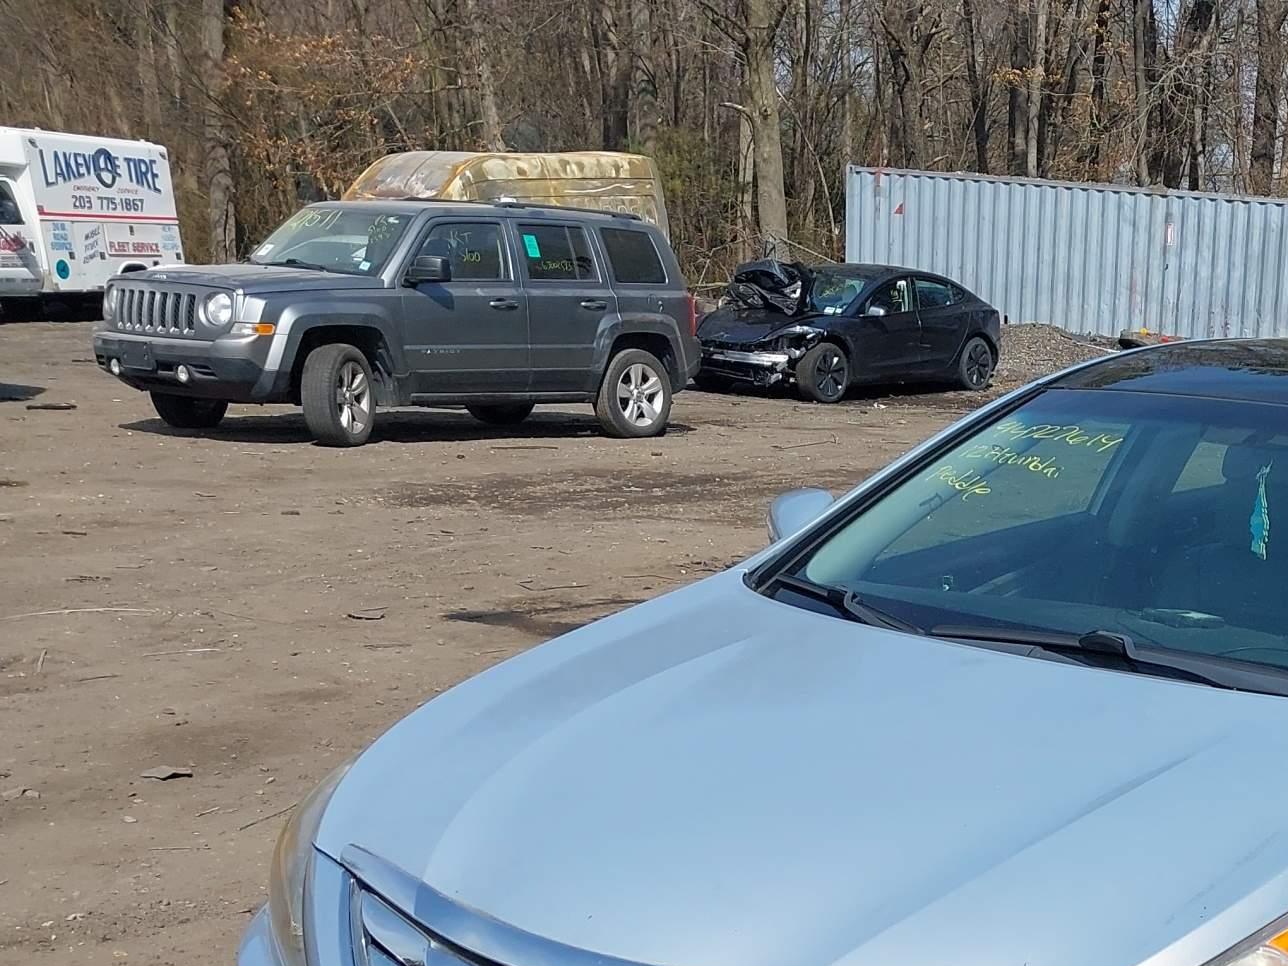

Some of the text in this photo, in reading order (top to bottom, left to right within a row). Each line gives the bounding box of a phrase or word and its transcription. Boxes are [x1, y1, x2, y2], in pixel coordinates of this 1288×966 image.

[124, 157, 162, 193] TIRE
[71, 194, 93, 210] 203
[109, 241, 161, 253] FLEET SERVICE
